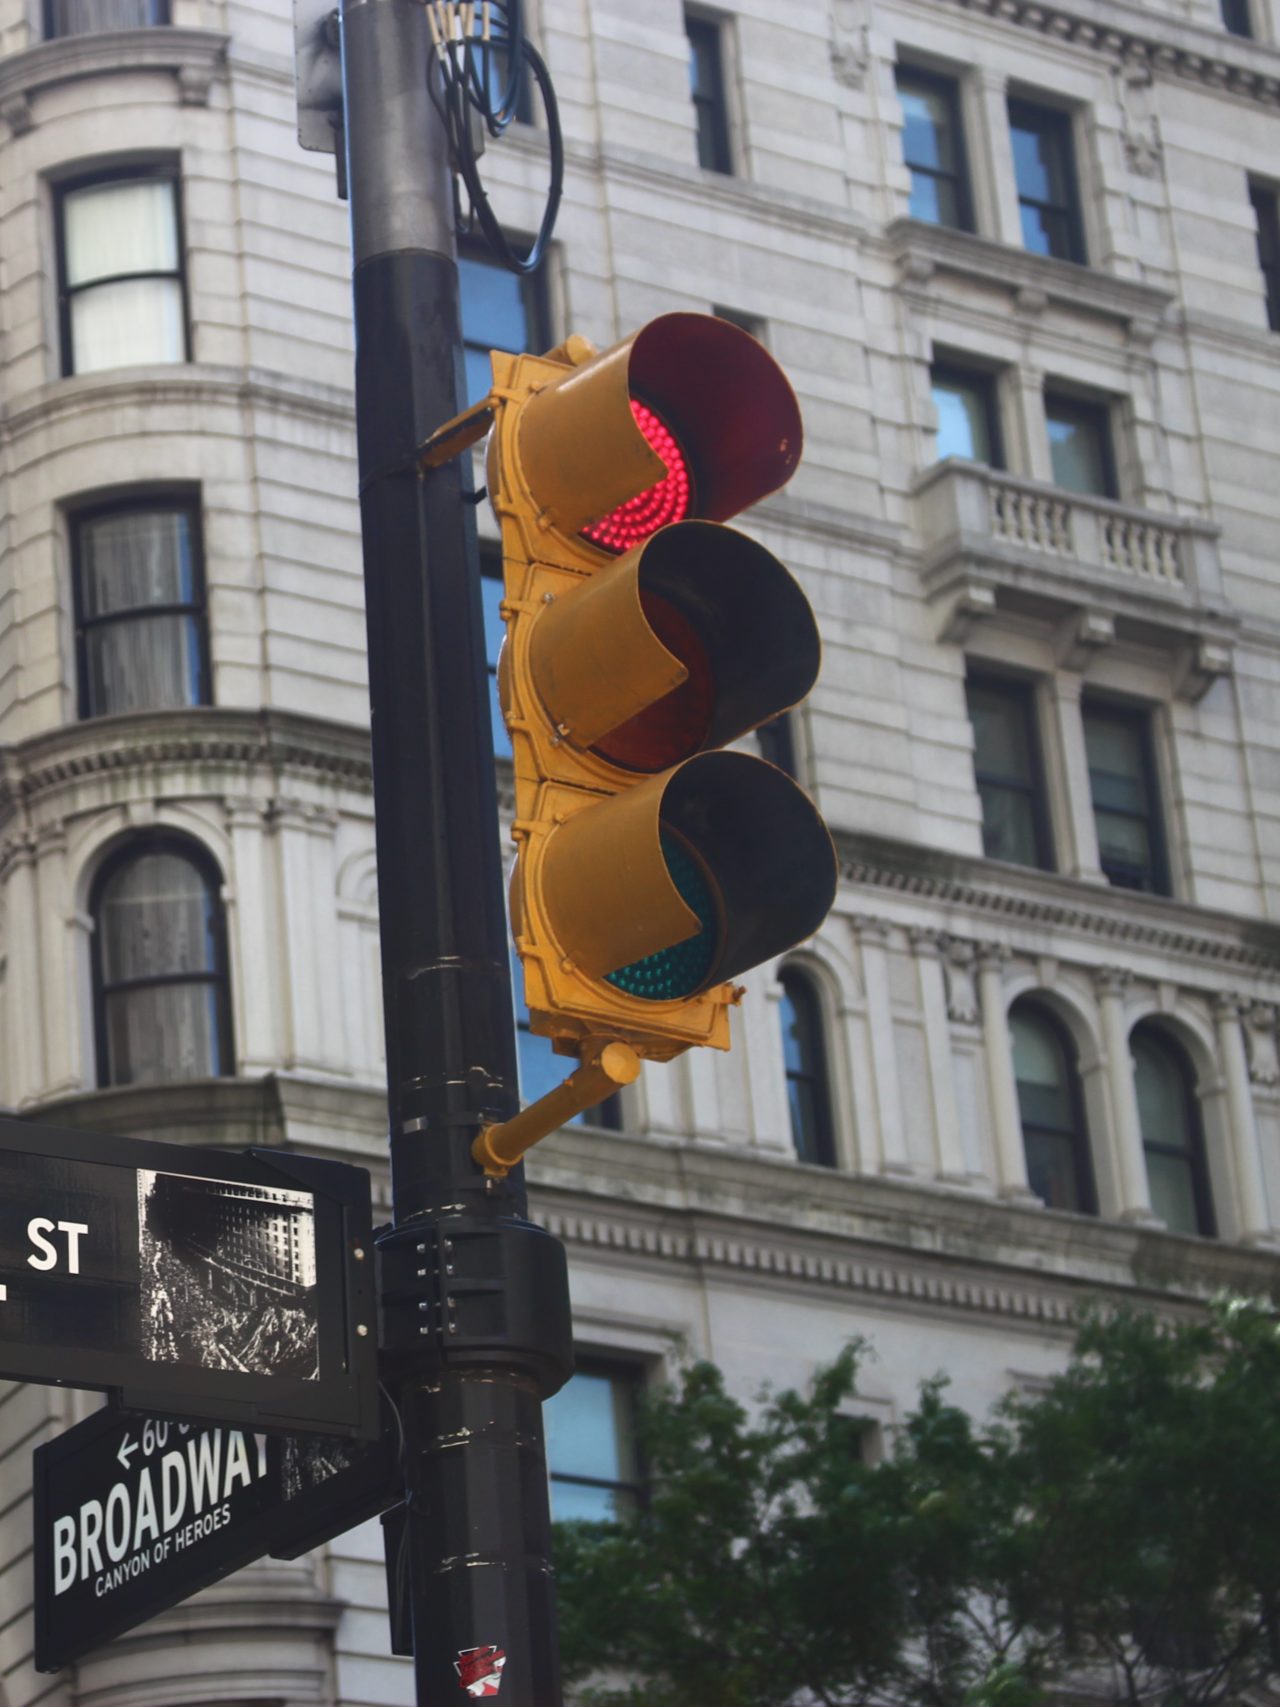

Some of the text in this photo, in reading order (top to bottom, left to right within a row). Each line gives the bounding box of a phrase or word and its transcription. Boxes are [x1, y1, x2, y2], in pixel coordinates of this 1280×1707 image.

[26, 1217, 89, 1275] ST
[53, 1428, 268, 1596] BROADWAY
[95, 1503, 231, 1597] CANYON OF HEROES
